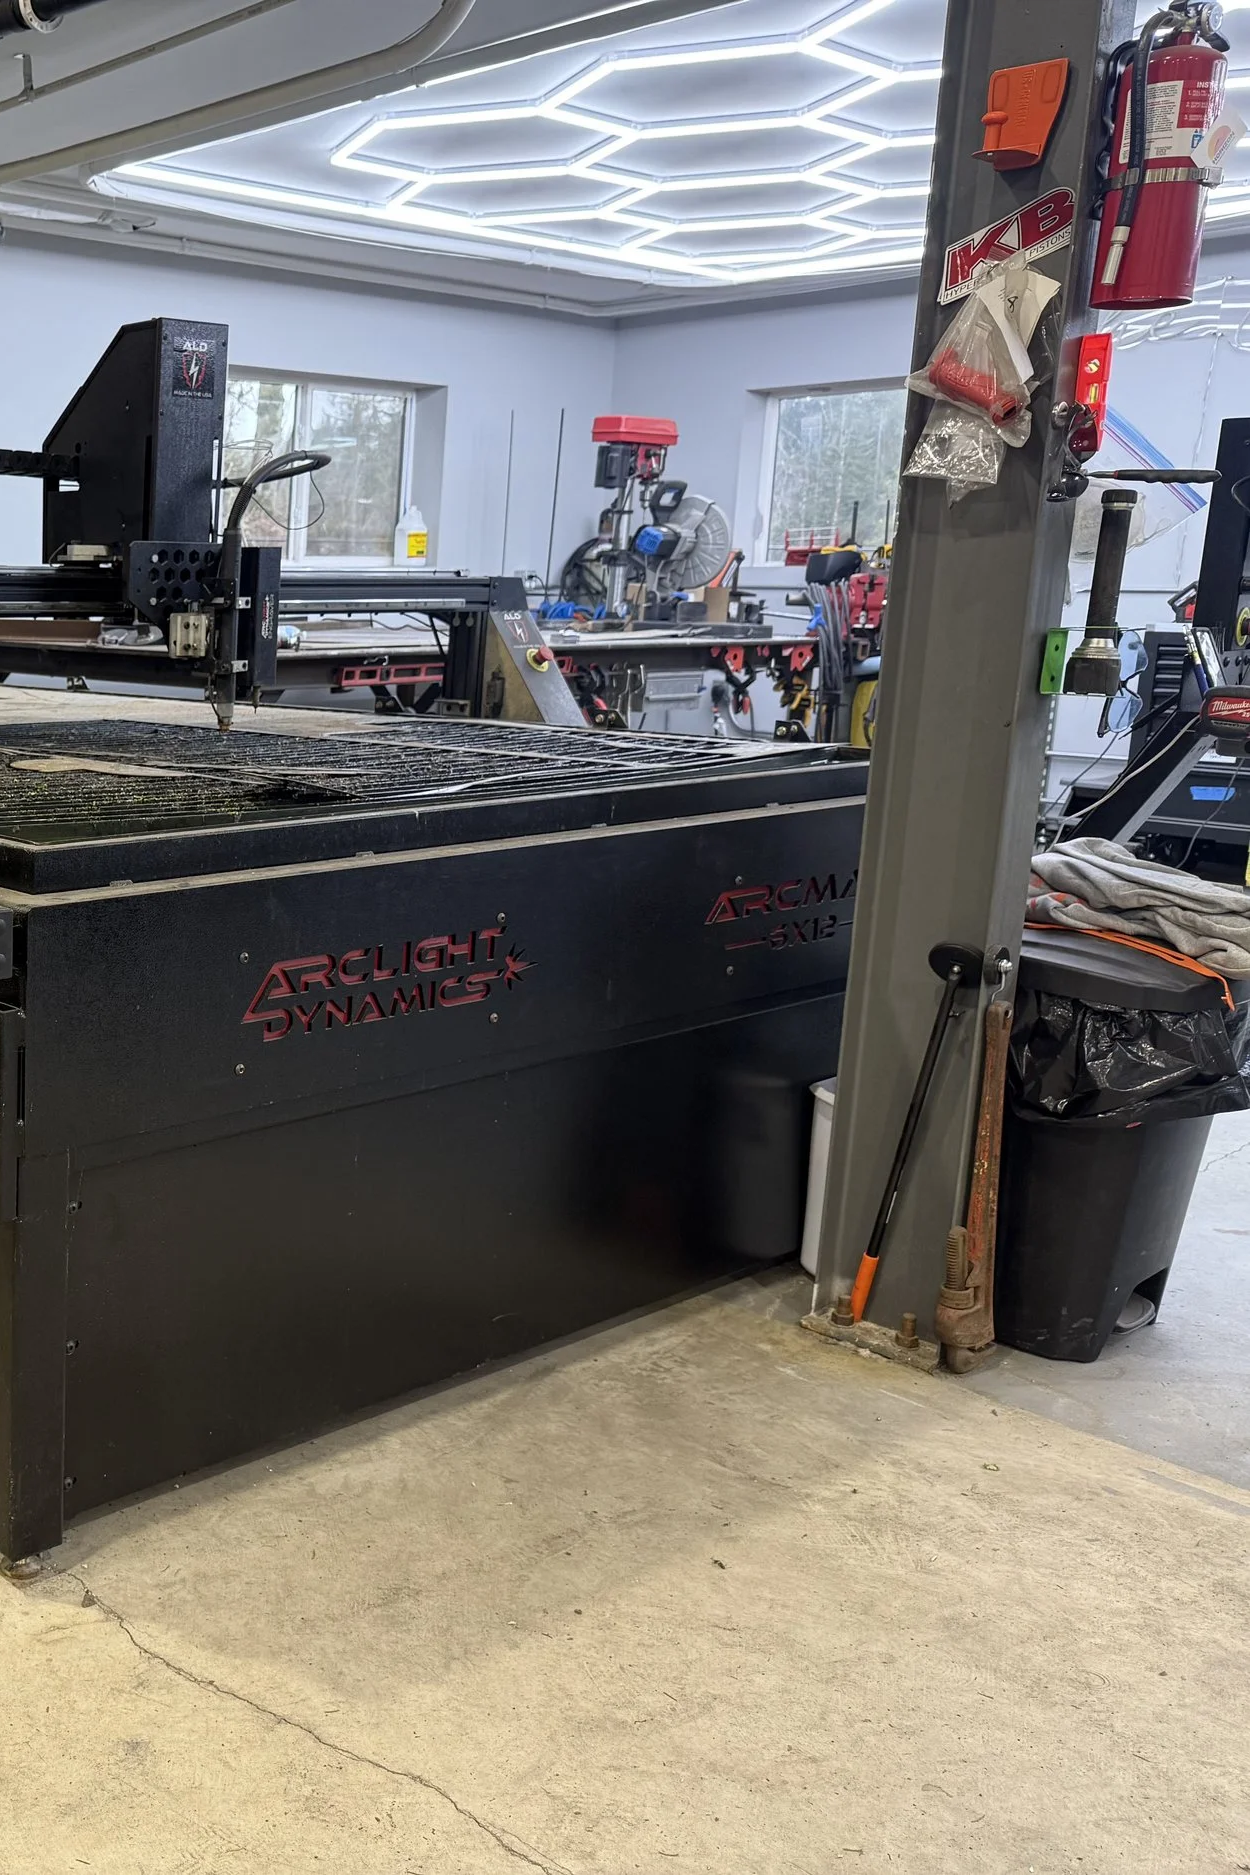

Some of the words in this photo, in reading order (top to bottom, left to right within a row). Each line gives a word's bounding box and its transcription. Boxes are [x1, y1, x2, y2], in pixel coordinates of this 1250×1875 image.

[1029, 228, 1071, 257] PISTONS
[183, 341, 208, 352] ALD
[1211, 701, 1250, 712] Milwauke
[244, 926, 507, 1008] ARCLIGHT
[246, 969, 503, 1042] DYNAMICS
